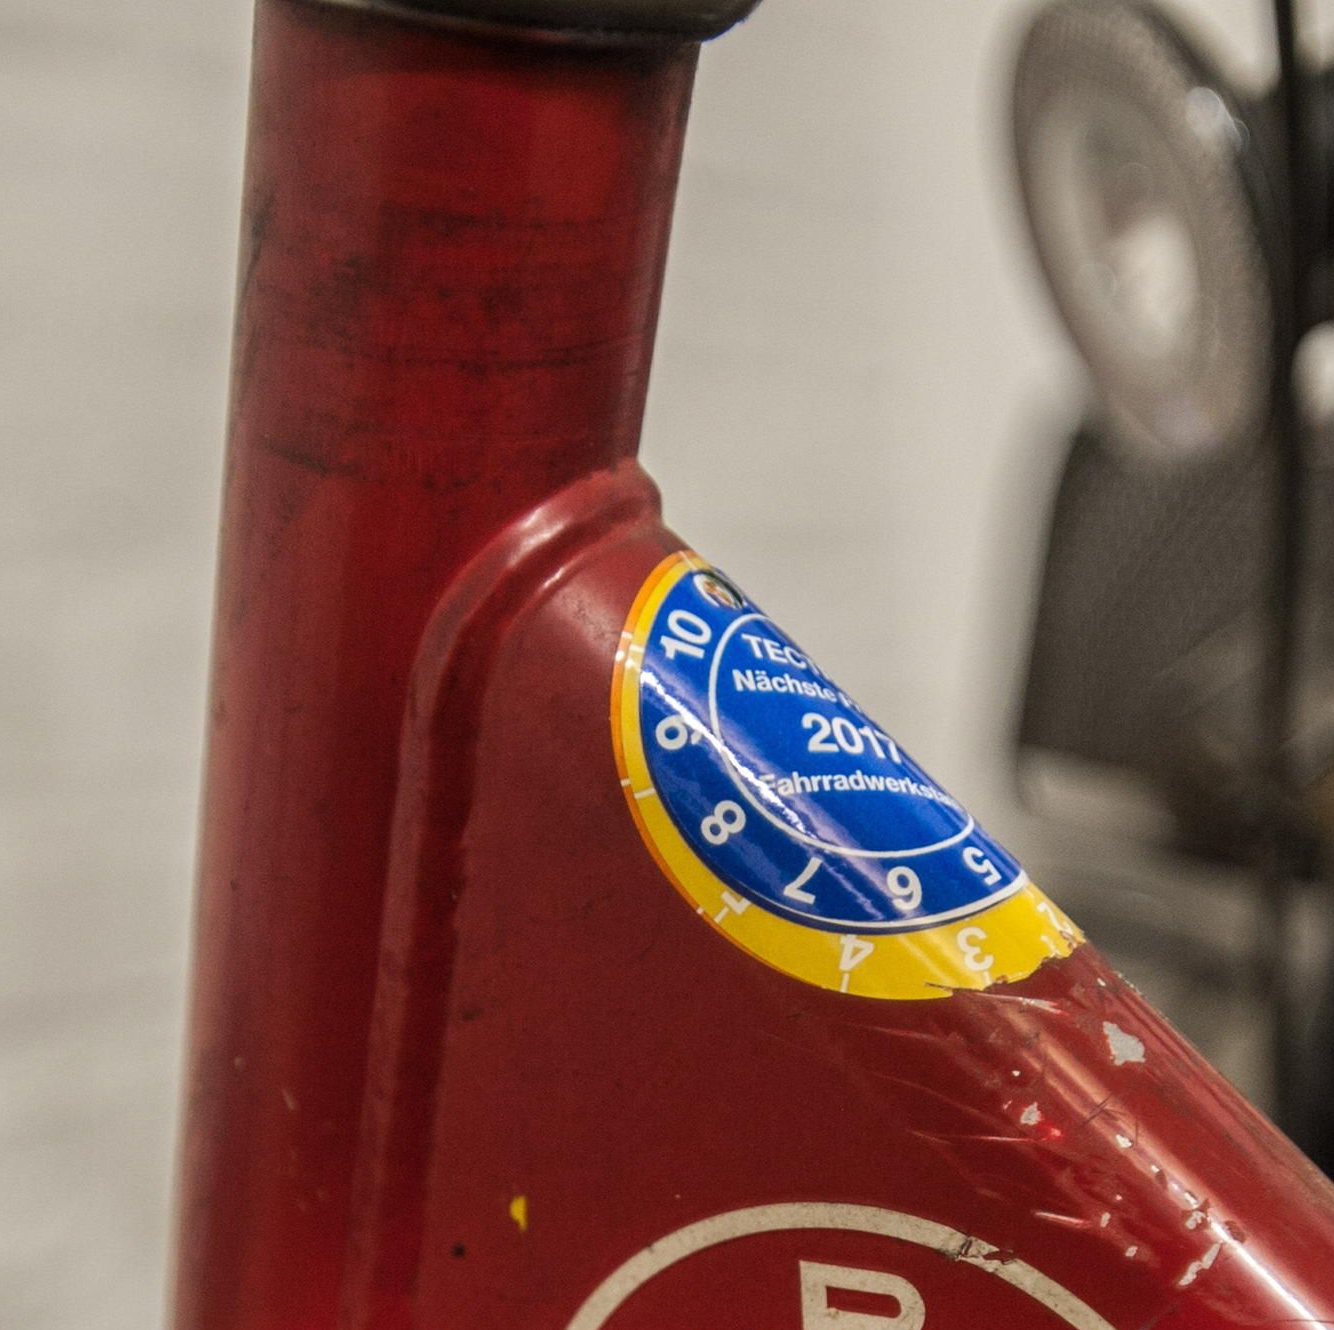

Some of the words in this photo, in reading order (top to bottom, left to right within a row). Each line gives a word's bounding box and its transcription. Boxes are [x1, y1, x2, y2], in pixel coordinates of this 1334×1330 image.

[660, 609, 712, 660] 10
[731, 669, 838, 703] Nächste
[801, 711, 902, 764] 2017
[700, 799, 747, 845] 8
[782, 856, 824, 905] 7
[886, 866, 924, 911] 6
[962, 846, 1003, 887] 5
[838, 934, 876, 972] 4
[956, 926, 995, 972] 3
